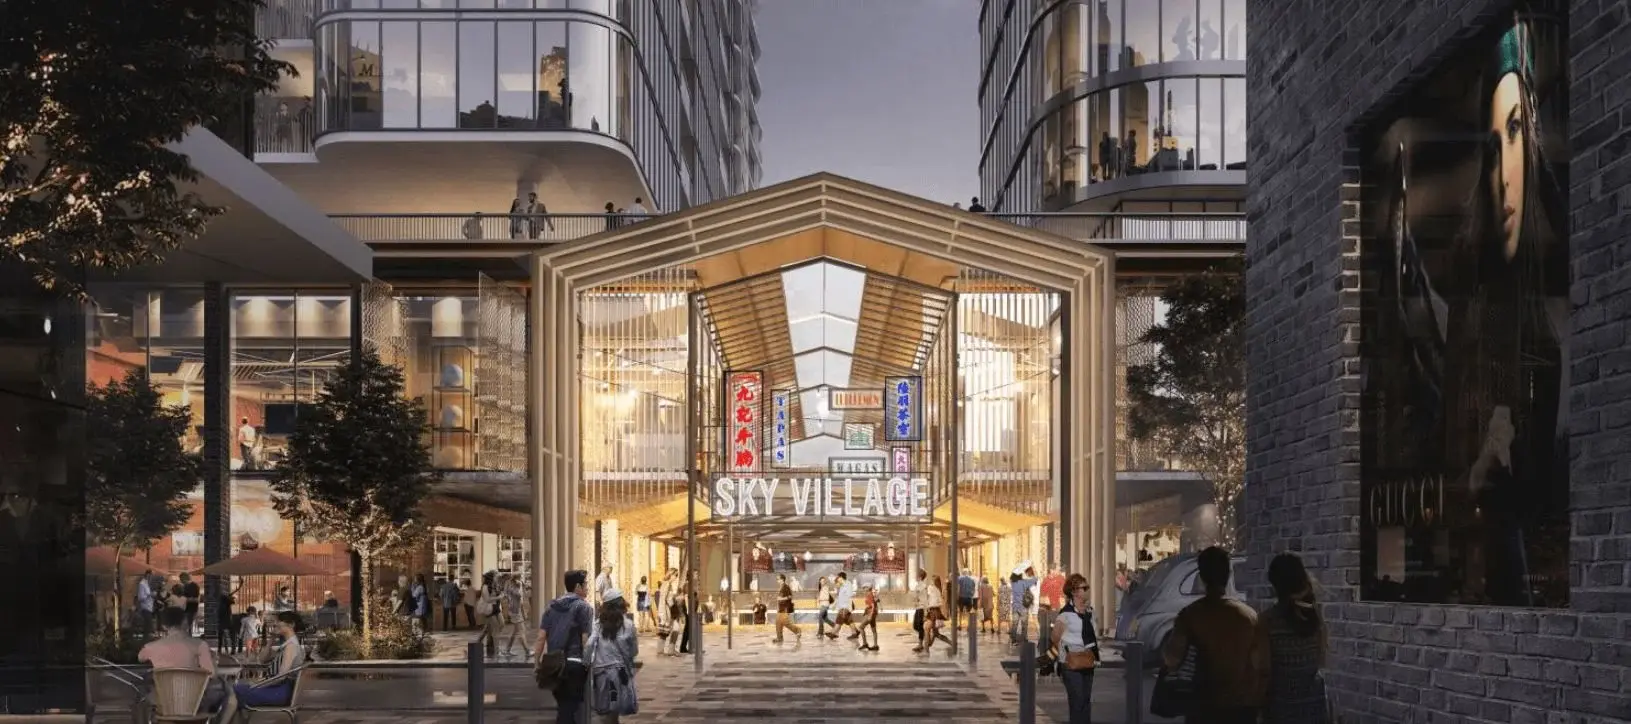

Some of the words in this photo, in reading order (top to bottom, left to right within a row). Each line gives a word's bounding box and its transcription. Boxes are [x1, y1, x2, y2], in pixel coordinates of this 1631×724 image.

[776, 396, 785, 461] TAPAS
[715, 477, 780, 517] SKY
[790, 477, 928, 517] VILLAGE
[1369, 473, 1444, 529] GUCCI
